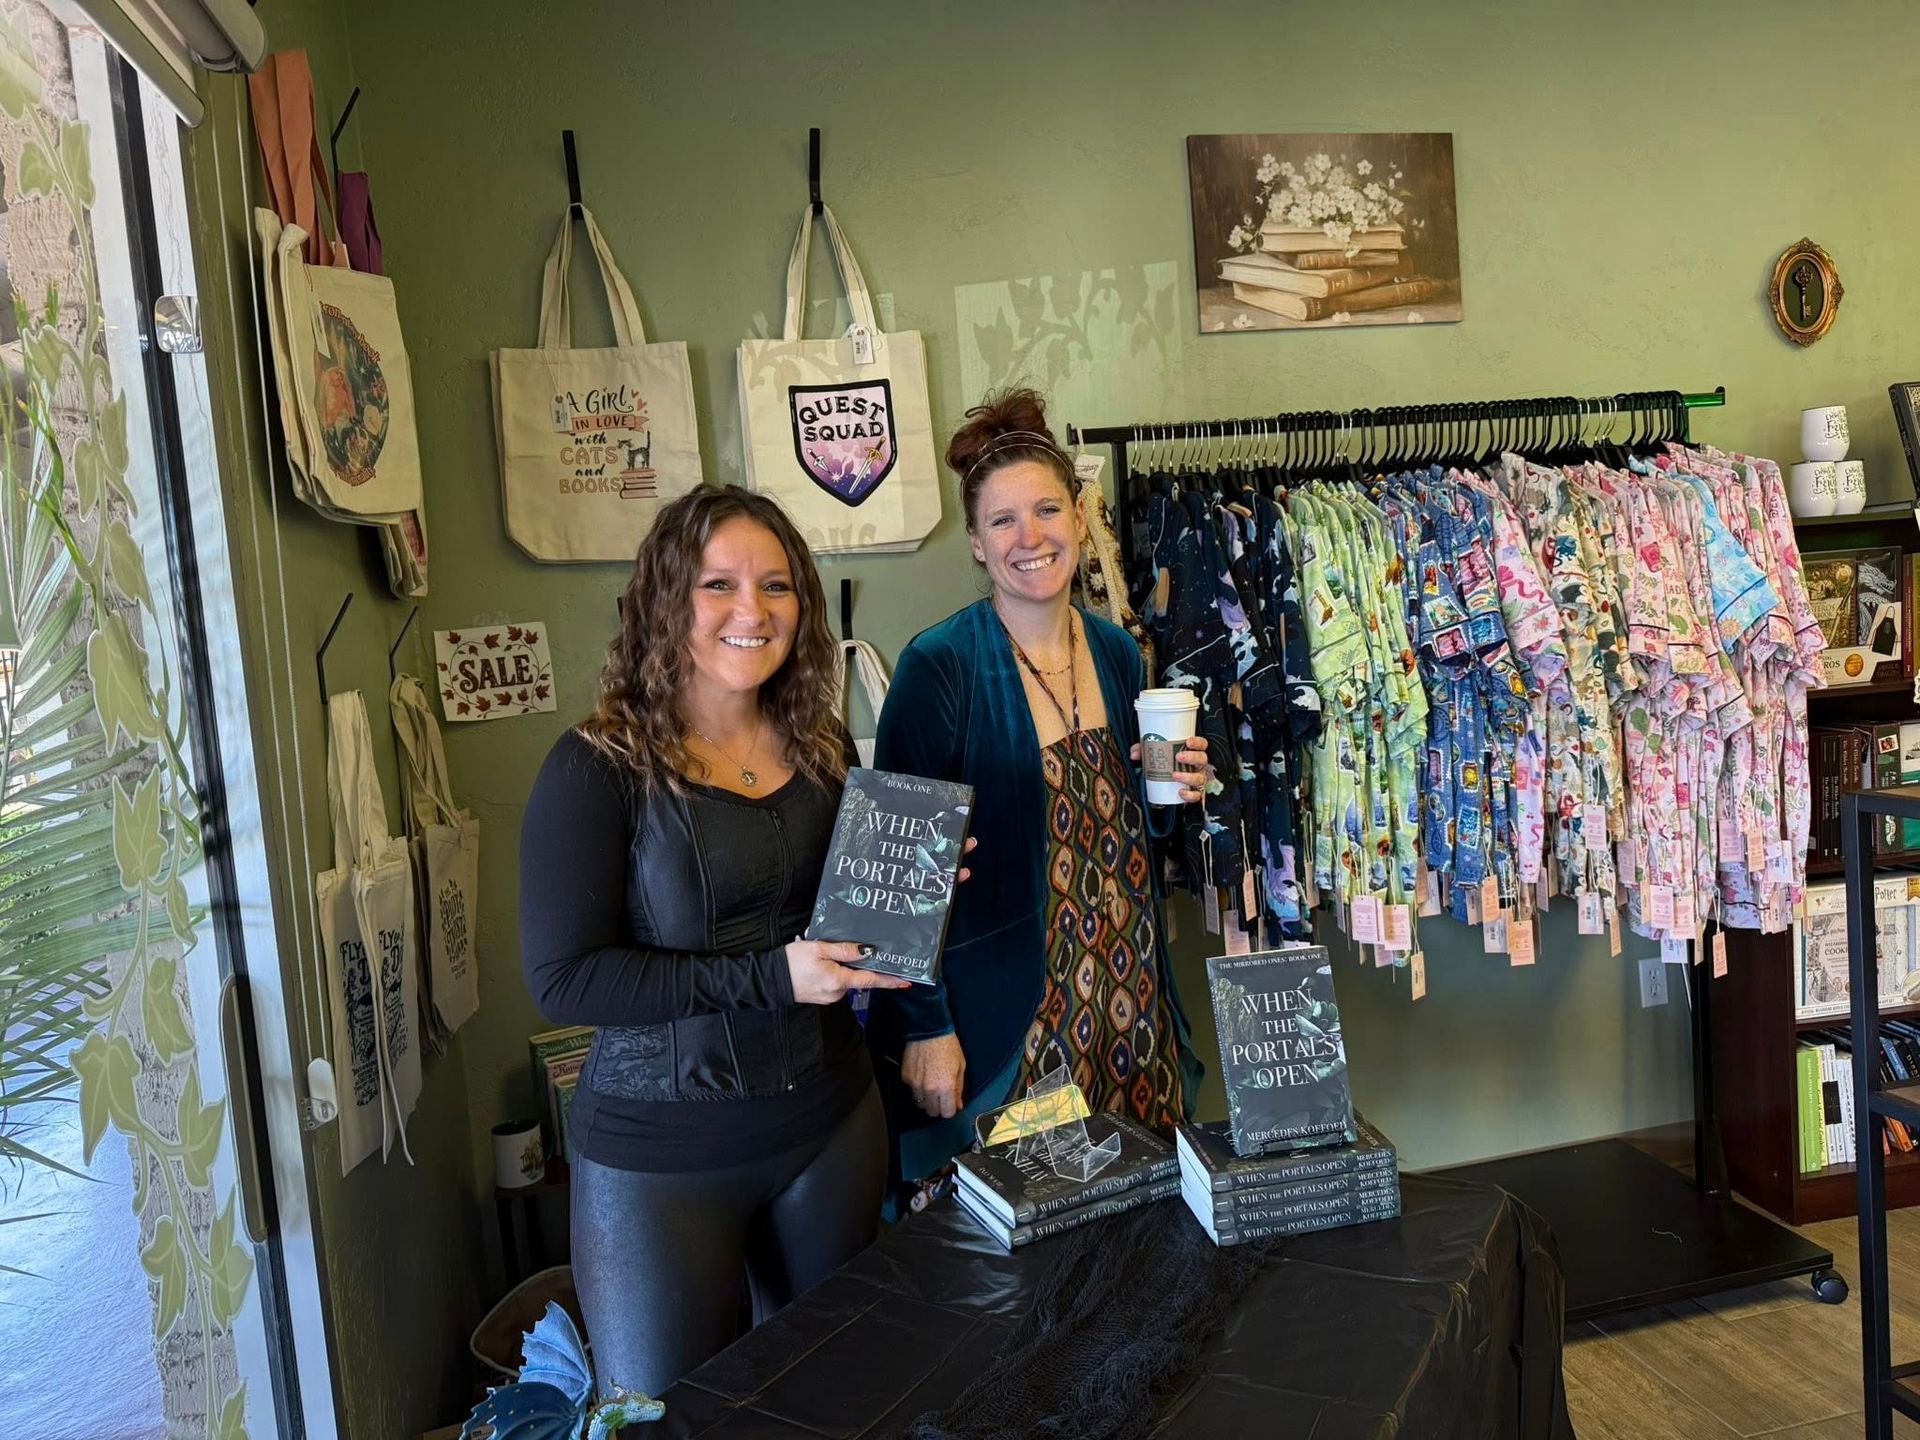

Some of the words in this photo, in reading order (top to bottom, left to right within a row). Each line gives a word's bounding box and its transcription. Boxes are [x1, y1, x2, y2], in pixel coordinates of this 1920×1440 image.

[566, 391, 581, 413] A
[799, 396, 885, 425] QUEST
[575, 419, 590, 430] IN
[596, 415, 629, 428] LOVE
[804, 421, 884, 442] SQUAD
[574, 432, 608, 445] with
[560, 446, 619, 465] CATS
[575, 464, 605, 477] and
[559, 478, 621, 494] BOOKS
[458, 654, 533, 694] SALE
[887, 779, 913, 791] BOOK
[913, 784, 933, 794] ONE
[867, 811, 943, 841] WHEN
[879, 840, 915, 860] THE
[835, 855, 947, 894] PORTALS
[852, 885, 920, 916] OPEN
[875, 951, 926, 969] KOEFOED
[1825, 946, 1847, 955] COOK
[1233, 960, 1267, 968] MIRRORED
[1240, 988, 1314, 1015] WHEN
[1261, 1018, 1298, 1035] THE
[1232, 1034, 1336, 1066] PORTALS
[1256, 1064, 1319, 1089] OPEN
[1246, 1126, 1300, 1142] MERCEDES
[1300, 1121, 1347, 1136] KOEFOED
[1237, 1172, 1266, 1184] WHEN
[1268, 1172, 1280, 1180] THE
[1282, 1164, 1320, 1178] PORTALS
[1322, 1160, 1347, 1170] OPEN
[1040, 1198, 1066, 1212] WHEN
[1068, 1195, 1080, 1204] THE
[1082, 1182, 1118, 1199] PORTALS
[1120, 1172, 1142, 1186] OPEN
[1239, 1192, 1267, 1205] WHEN
[1284, 1184, 1323, 1198] PORTALS
[1324, 1179, 1348, 1188] OPEN
[1036, 1222, 1064, 1238] WHEN
[1066, 1219, 1078, 1227] THE
[1080, 1206, 1118, 1222] PORTALS
[1118, 1196, 1140, 1210] OPEN
[1240, 1210, 1268, 1222] WHEN
[1270, 1210, 1284, 1218] THE
[1284, 1202, 1324, 1215] PORTALS
[1326, 1197, 1350, 1207] OPEN
[1244, 1226, 1271, 1238] WHEN
[1288, 1217, 1327, 1230] PORTALS
[1328, 1212, 1351, 1222] OPEN
